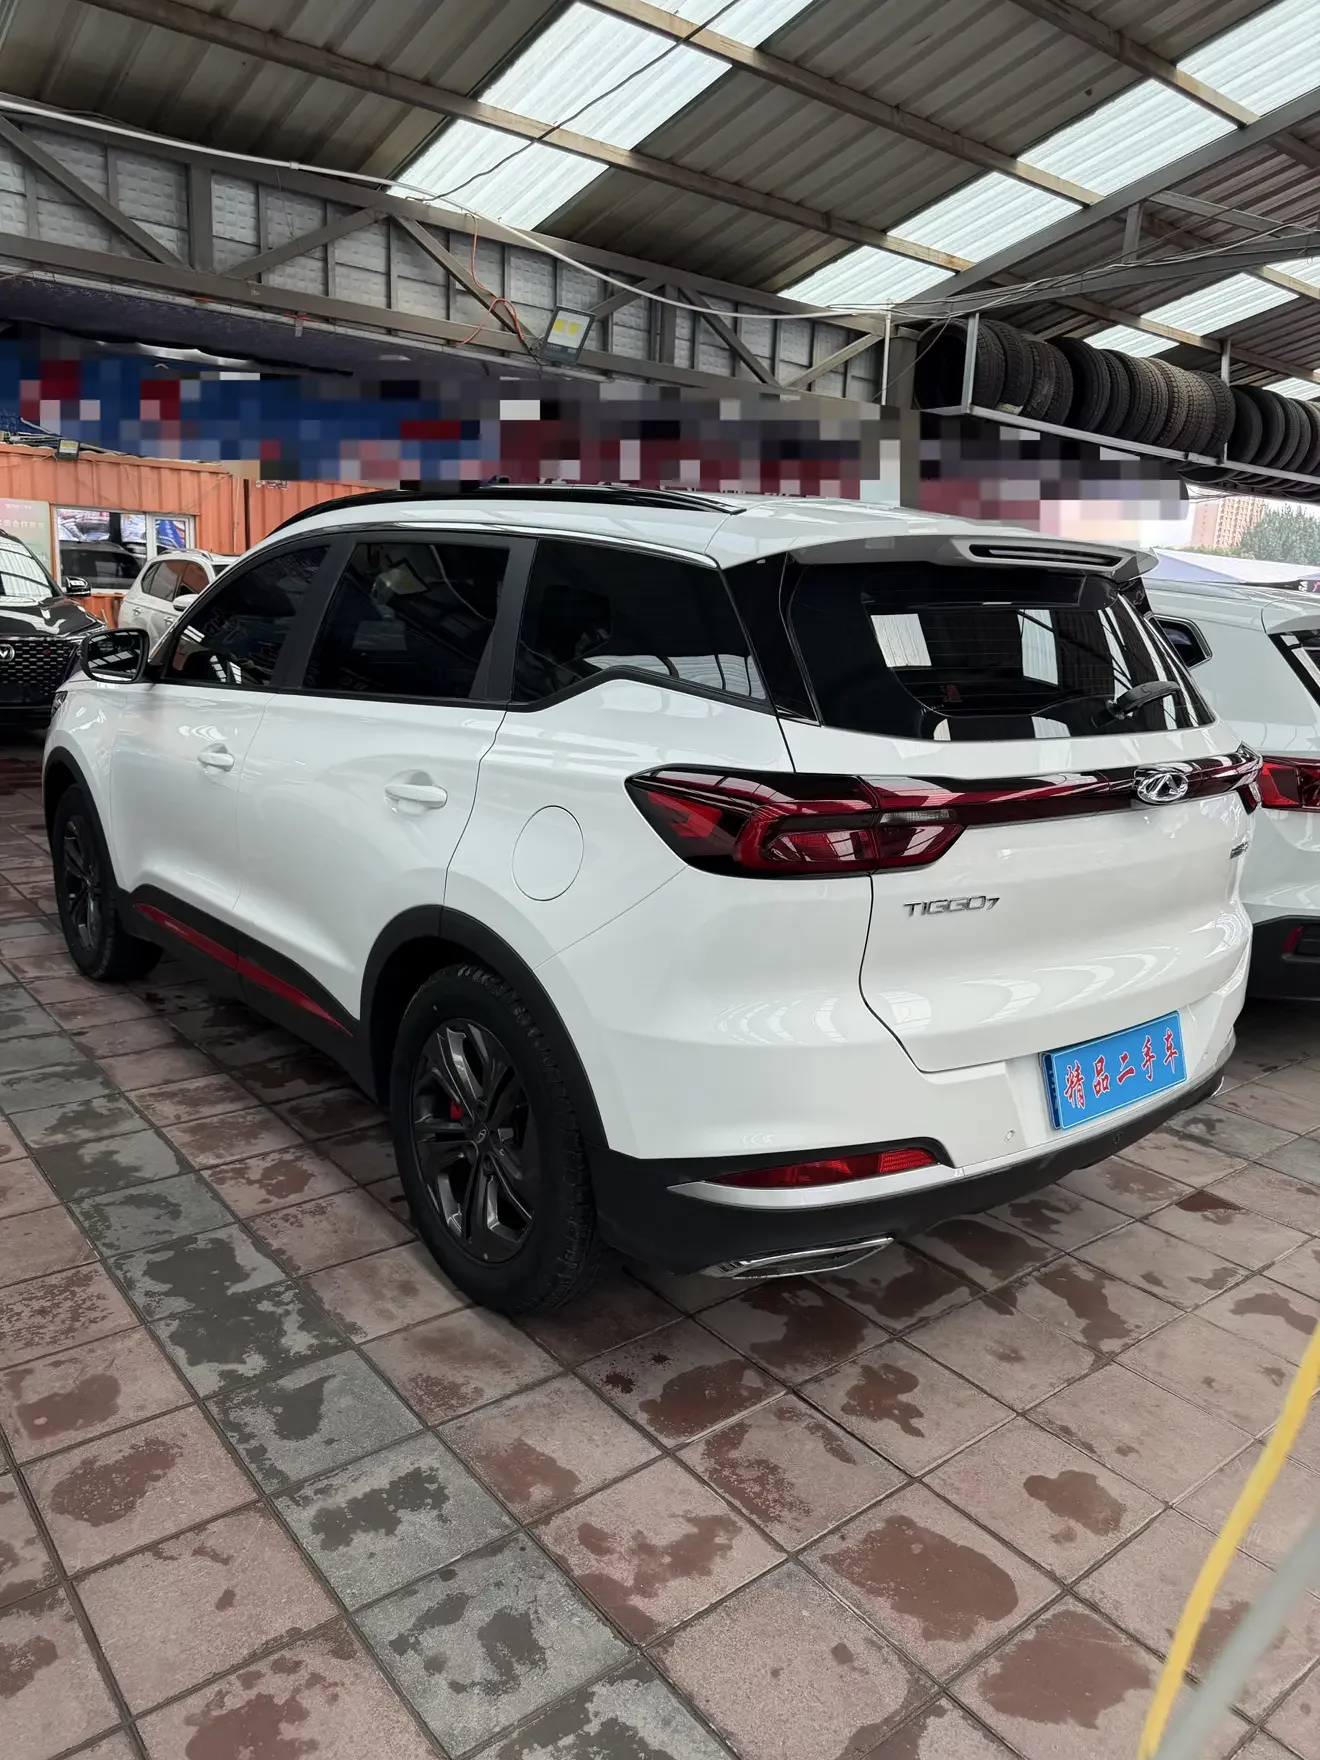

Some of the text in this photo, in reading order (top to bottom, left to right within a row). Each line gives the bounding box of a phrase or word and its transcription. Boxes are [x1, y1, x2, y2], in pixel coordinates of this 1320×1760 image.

[1064, 1027, 1178, 1110] 精品二手车
